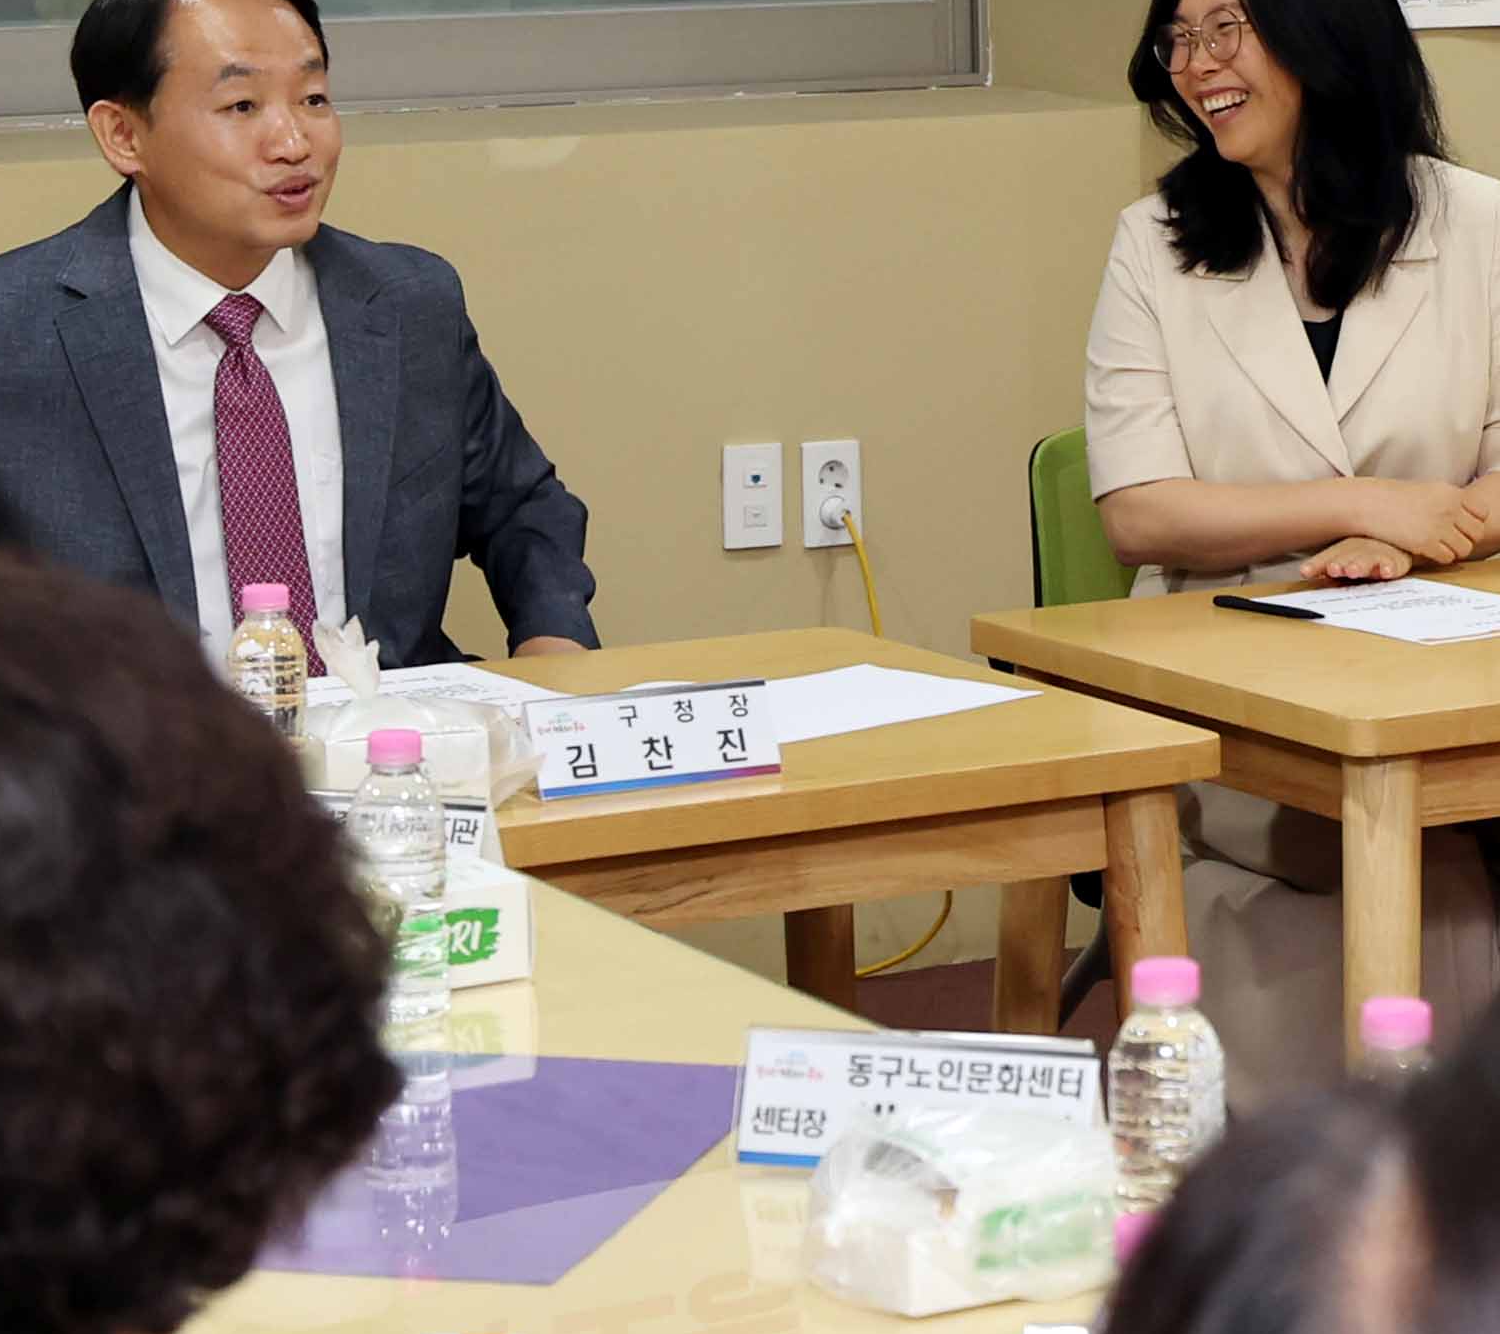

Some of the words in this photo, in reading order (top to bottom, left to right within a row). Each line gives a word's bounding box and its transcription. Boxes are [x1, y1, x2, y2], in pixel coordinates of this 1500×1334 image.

[618, 705, 638, 727] 구
[673, 699, 695, 723] 청
[728, 693, 749, 718] 장
[565, 743, 598, 780] 김
[642, 736, 673, 771] 찬
[716, 728, 748, 763] 진
[848, 1055, 1084, 1099] 동구노인문화센터
[752, 1105, 827, 1139] 센터장
